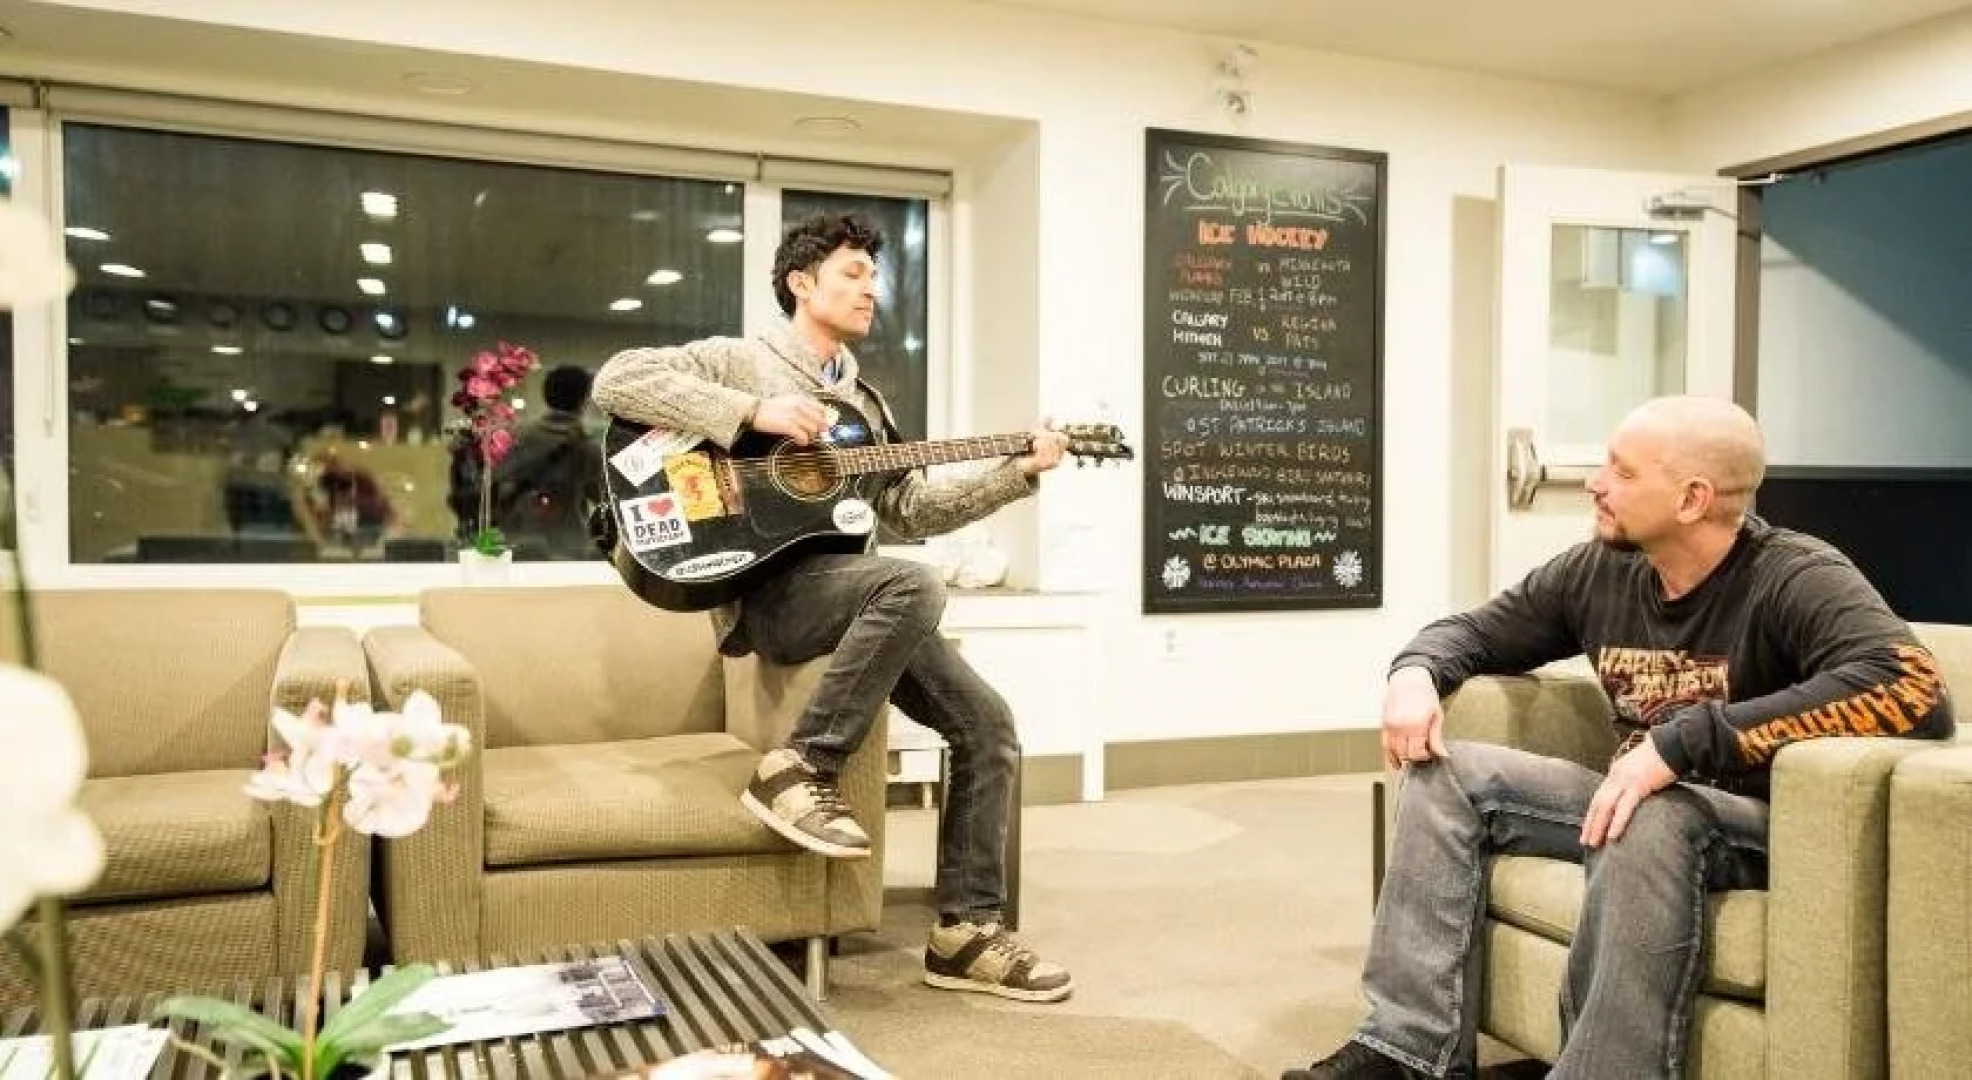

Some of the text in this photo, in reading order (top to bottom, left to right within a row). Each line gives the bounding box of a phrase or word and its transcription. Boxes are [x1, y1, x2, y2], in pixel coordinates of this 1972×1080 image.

[1199, 220, 1235, 244] ICE
[1172, 309, 1228, 328] CALGARY
[1162, 375, 1246, 398] CURLING
[1295, 382, 1351, 400] ISLAND
[1161, 441, 1351, 463] SPOT WINTER BIRDS
[1162, 481, 1247, 506] WINSPORT
[629, 504, 643, 521] I
[635, 517, 681, 539] DEAD
[1199, 525, 1231, 546] ICE
[1279, 554, 1321, 570] PLAZA
